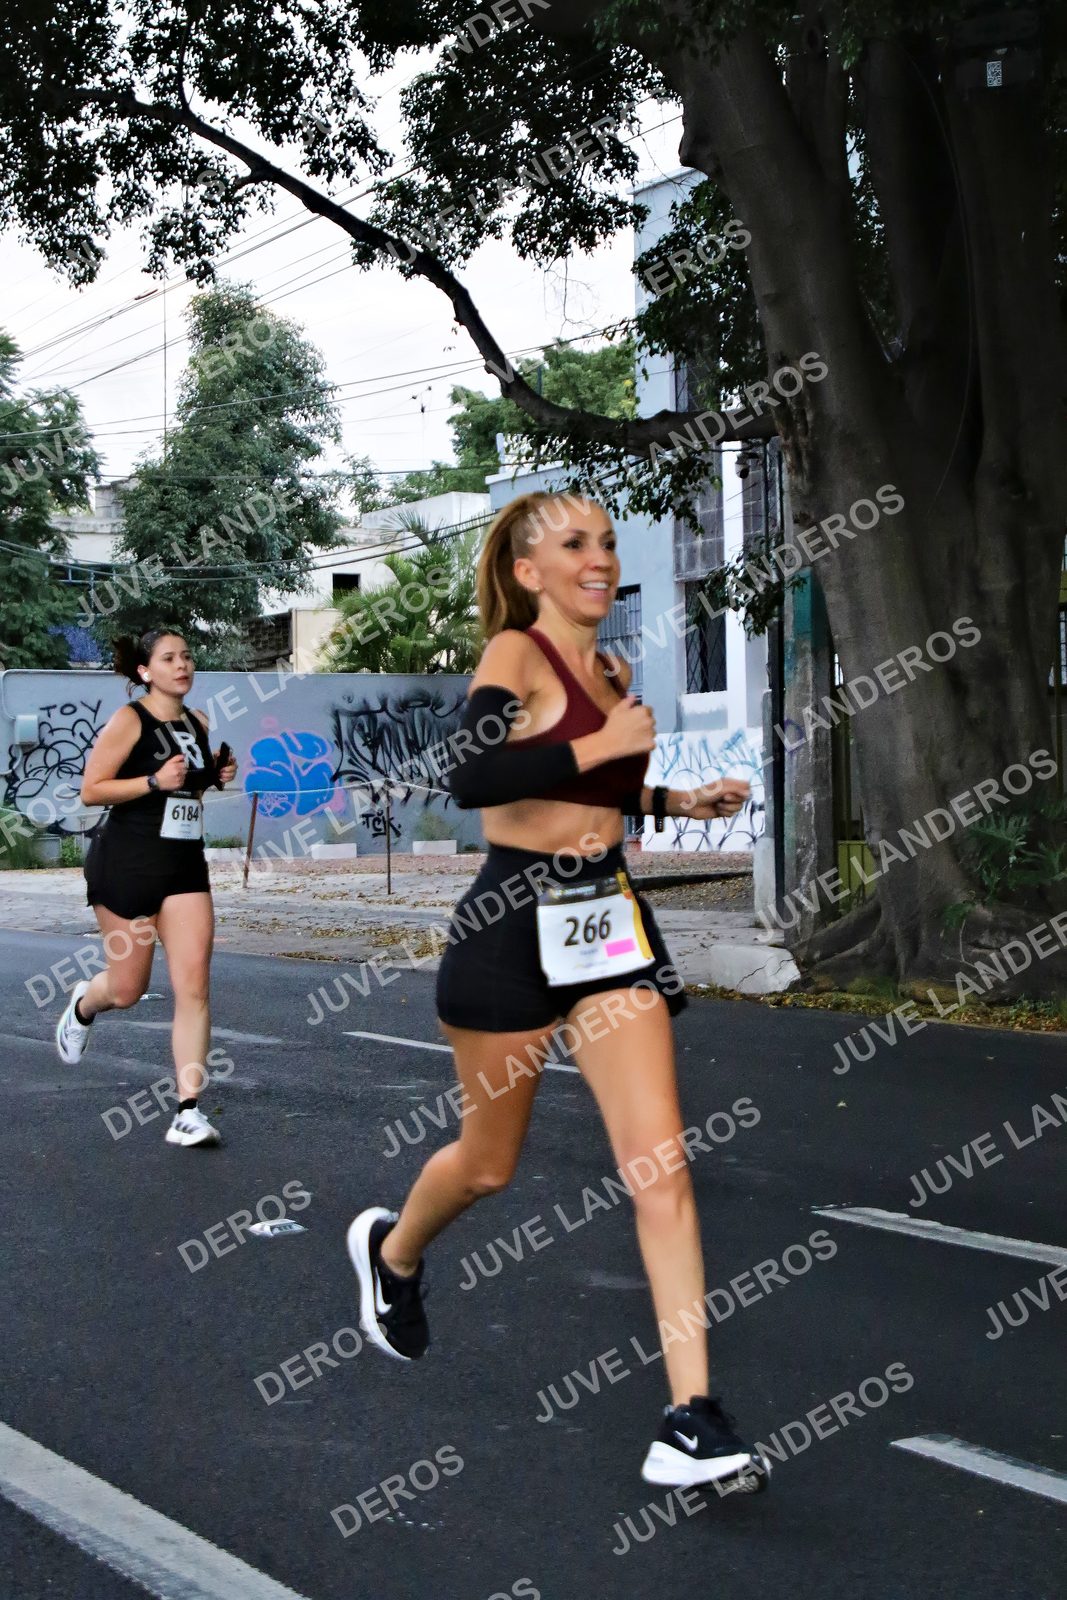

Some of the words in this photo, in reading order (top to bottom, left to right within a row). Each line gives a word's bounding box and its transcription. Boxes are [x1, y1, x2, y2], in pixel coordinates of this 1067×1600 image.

[40, 699, 102, 723] TOY
[171, 804, 200, 822] 6184
[564, 908, 612, 946] 266
